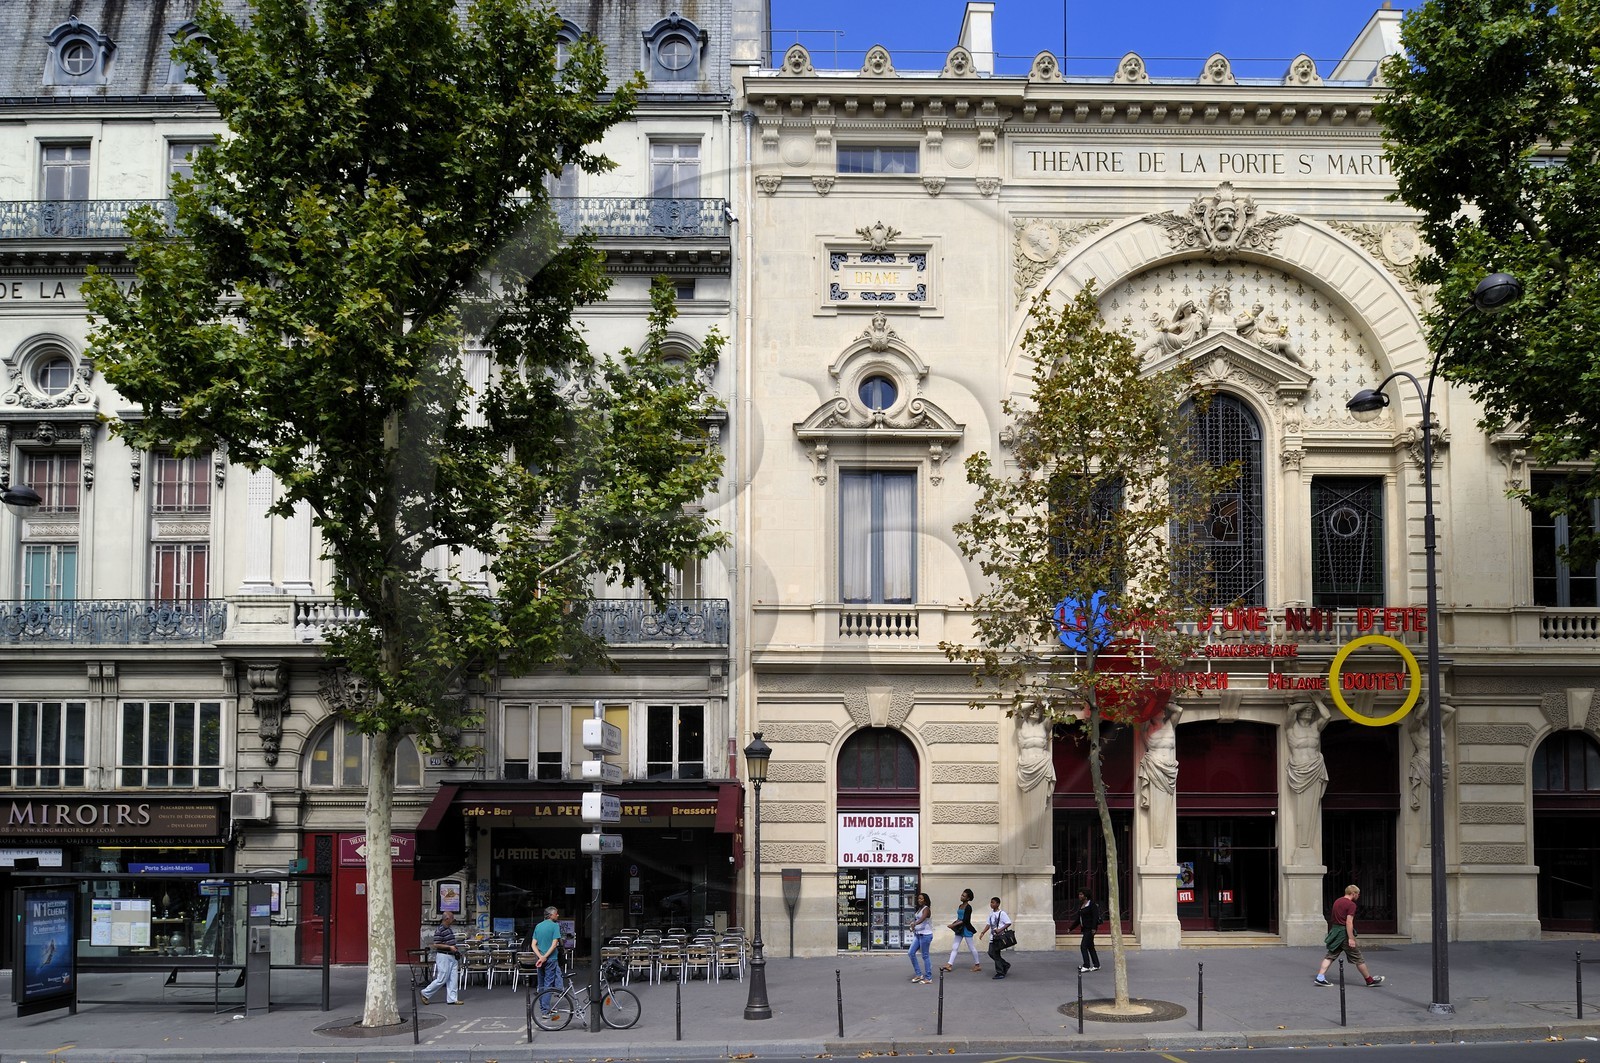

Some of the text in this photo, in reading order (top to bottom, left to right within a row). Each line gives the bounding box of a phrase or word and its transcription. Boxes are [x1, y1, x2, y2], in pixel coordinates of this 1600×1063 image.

[1028, 150, 1124, 173] THEATRE
[1138, 152, 1166, 173] DE
[1180, 153, 1206, 174] LA
[1219, 153, 1286, 175] PORTE
[1327, 154, 1394, 176] MARTI
[854, 271, 901, 285] DRAME
[40, 281, 66, 299] LA
[1285, 607, 1333, 632] NUIT
[1357, 607, 1428, 632] D'ETE
[1204, 644, 1299, 658] SHAKESPEARE
[1268, 672, 1326, 690] MELANIE
[1343, 672, 1407, 690] DOUTEY
[8, 801, 151, 825] MIROIRS
[462, 807, 485, 816] Café
[494, 807, 513, 816] Bar
[535, 806, 552, 816] LA
[557, 806, 582, 816] PET
[842, 816, 914, 828] IMMOBILIER
[493, 848, 505, 860] LA
[507, 847, 539, 860] PETITE
[542, 848, 576, 860] PORTE
[843, 853, 914, 863] 01.40.18.78.78
[1179, 891, 1193, 903] RTL
[47, 907, 66, 916] CLIENT
